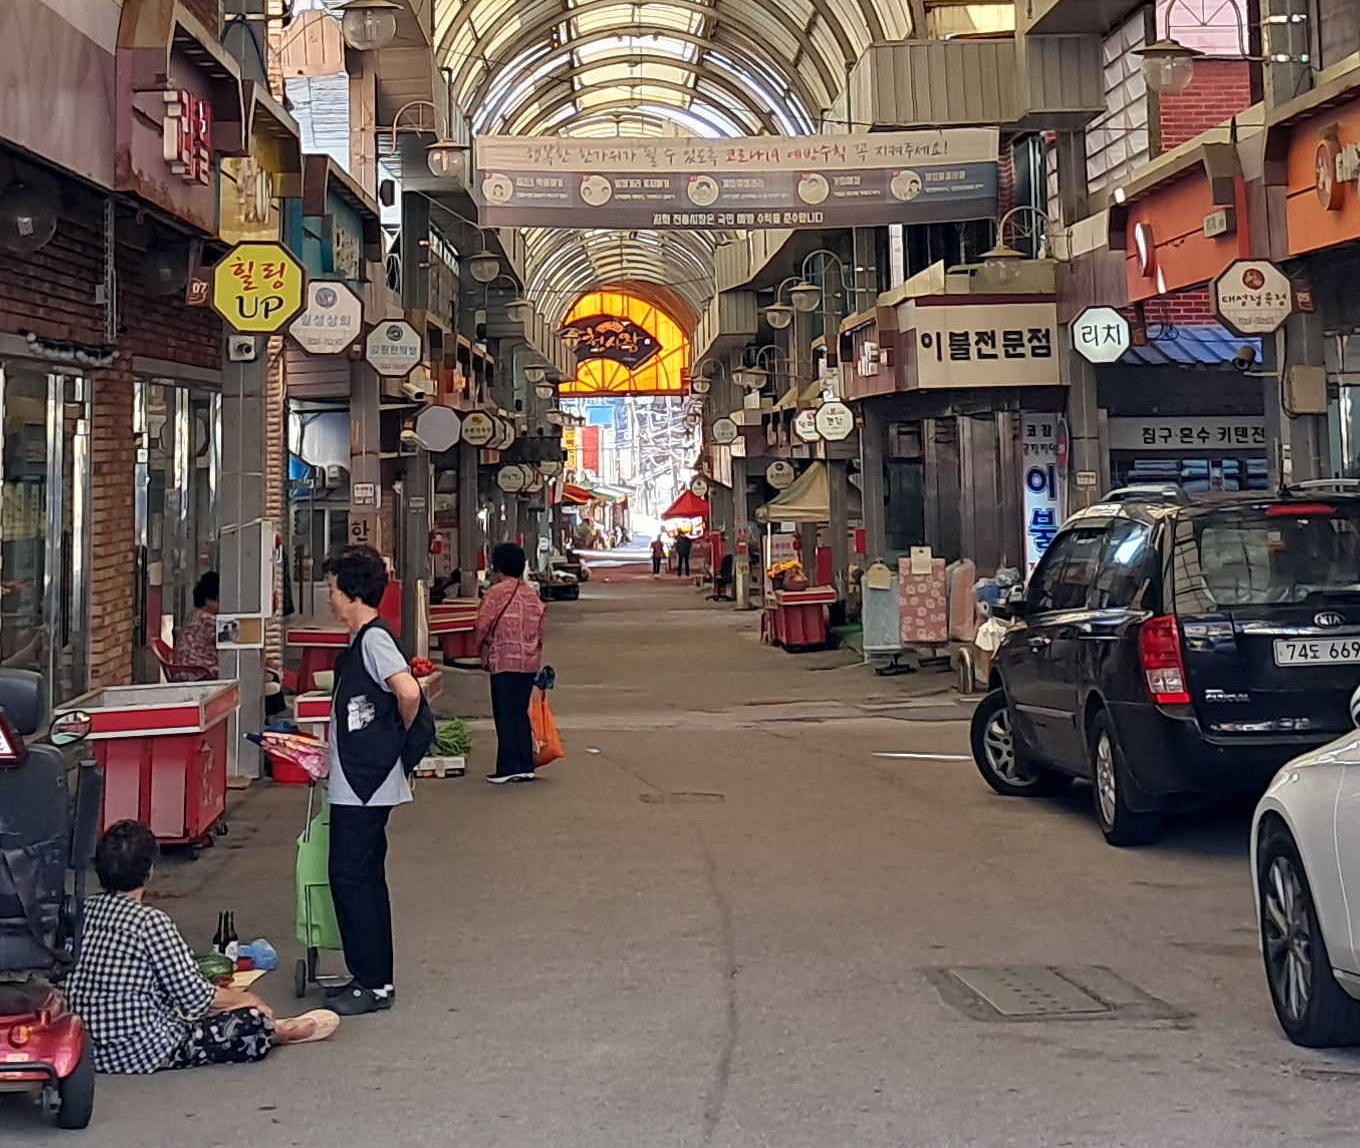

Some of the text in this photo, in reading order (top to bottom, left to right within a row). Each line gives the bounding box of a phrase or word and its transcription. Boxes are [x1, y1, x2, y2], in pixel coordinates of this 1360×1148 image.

[526, 145, 570, 163] 행복한
[578, 146, 636, 164] 한가위가
[665, 146, 676, 165] 수
[683, 147, 718, 167] 있도록
[725, 146, 780, 164] 코로나19
[787, 143, 846, 164] 예방수칙
[853, 142, 868, 161] 꼭
[875, 140, 948, 159] 지켜주세요!
[230, 256, 287, 292] 힐링
[193, 282, 208, 293] 07
[235, 295, 284, 320] UP
[920, 327, 1052, 362] 이불전문점
[1081, 323, 1122, 347] 리치
[1320, 614, 1341, 626] KIA
[1285, 643, 1320, 661] 74도
